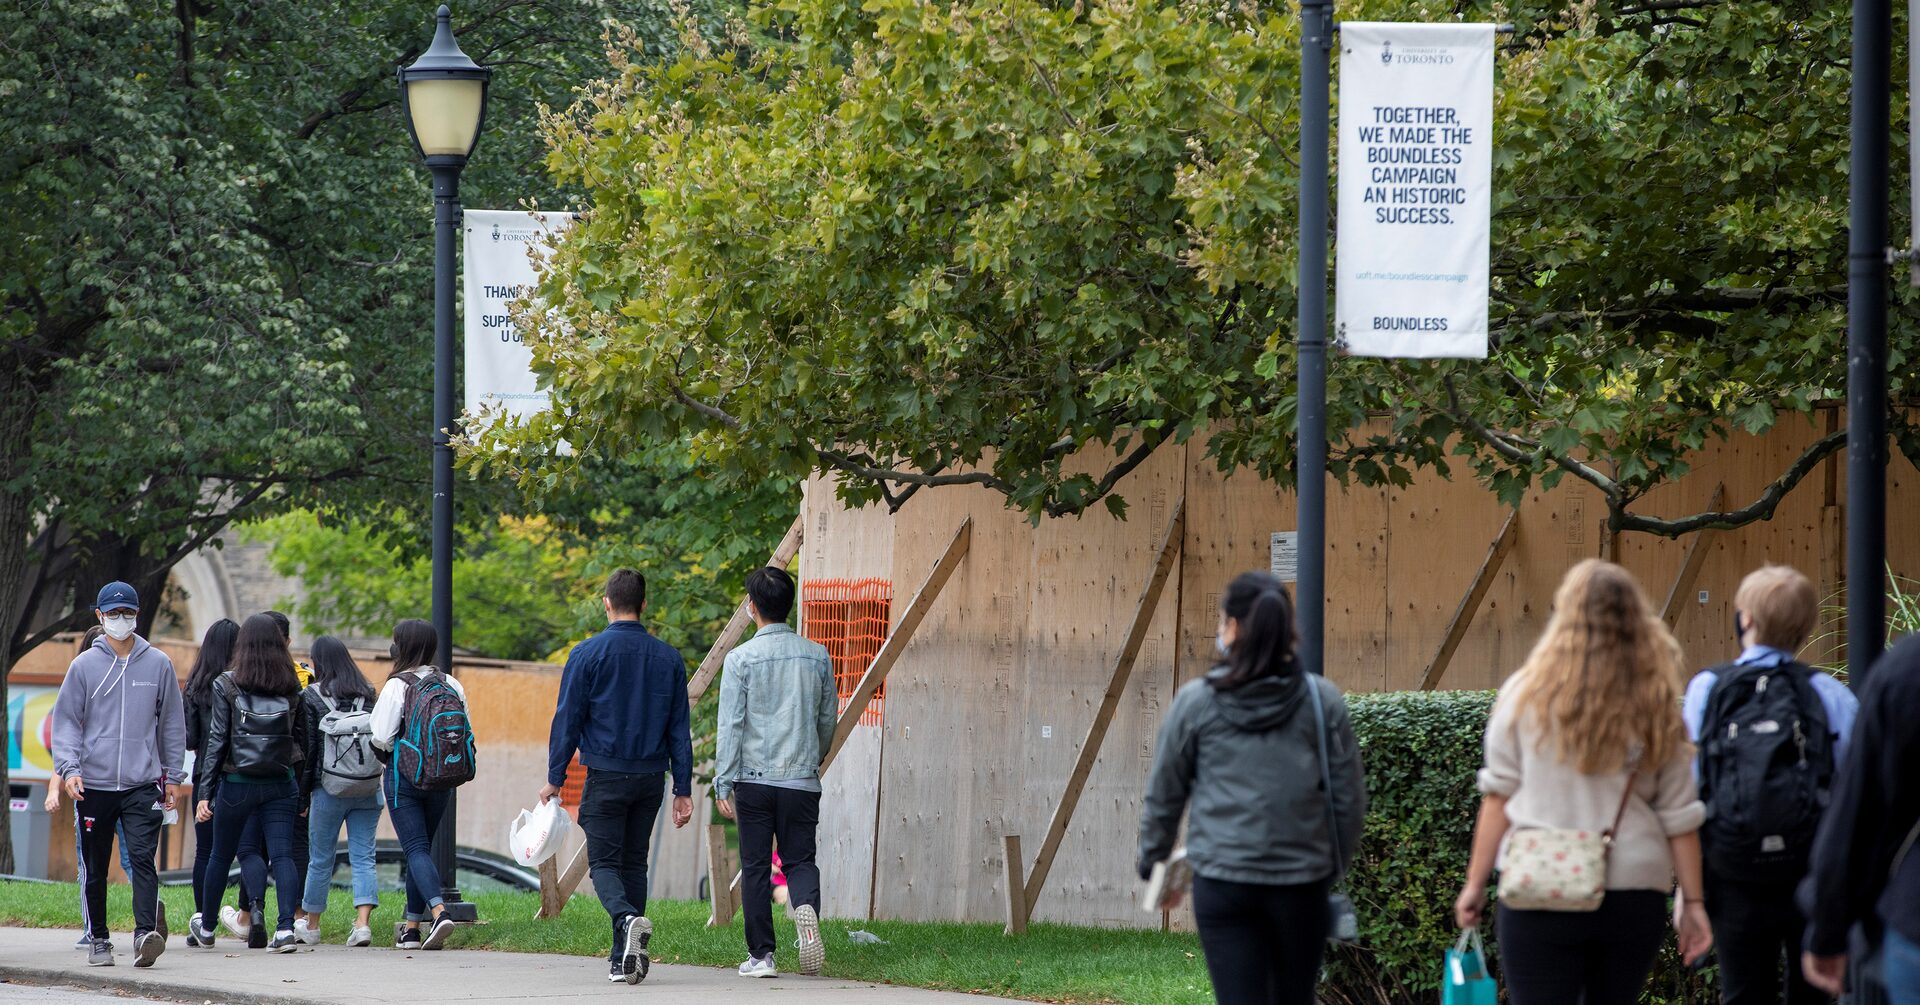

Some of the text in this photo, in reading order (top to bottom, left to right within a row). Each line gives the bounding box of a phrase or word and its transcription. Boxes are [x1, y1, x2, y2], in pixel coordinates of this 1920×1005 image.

[1396, 55, 1454, 64] TORONTO
[1373, 106, 1460, 127] TOGETHER,
[1358, 126, 1473, 144] WE MADE THE
[1368, 147, 1462, 164] BOUNDLESS
[1372, 167, 1456, 184] CAMPAIGN
[1364, 187, 1466, 204] AN HISTORIC
[1376, 207, 1454, 224] SUCCESS.
[1355, 271, 1469, 283] uoft.me/boundlesscampaign
[1373, 316, 1448, 331] BOUNDLESS
[501, 330, 510, 342] U
